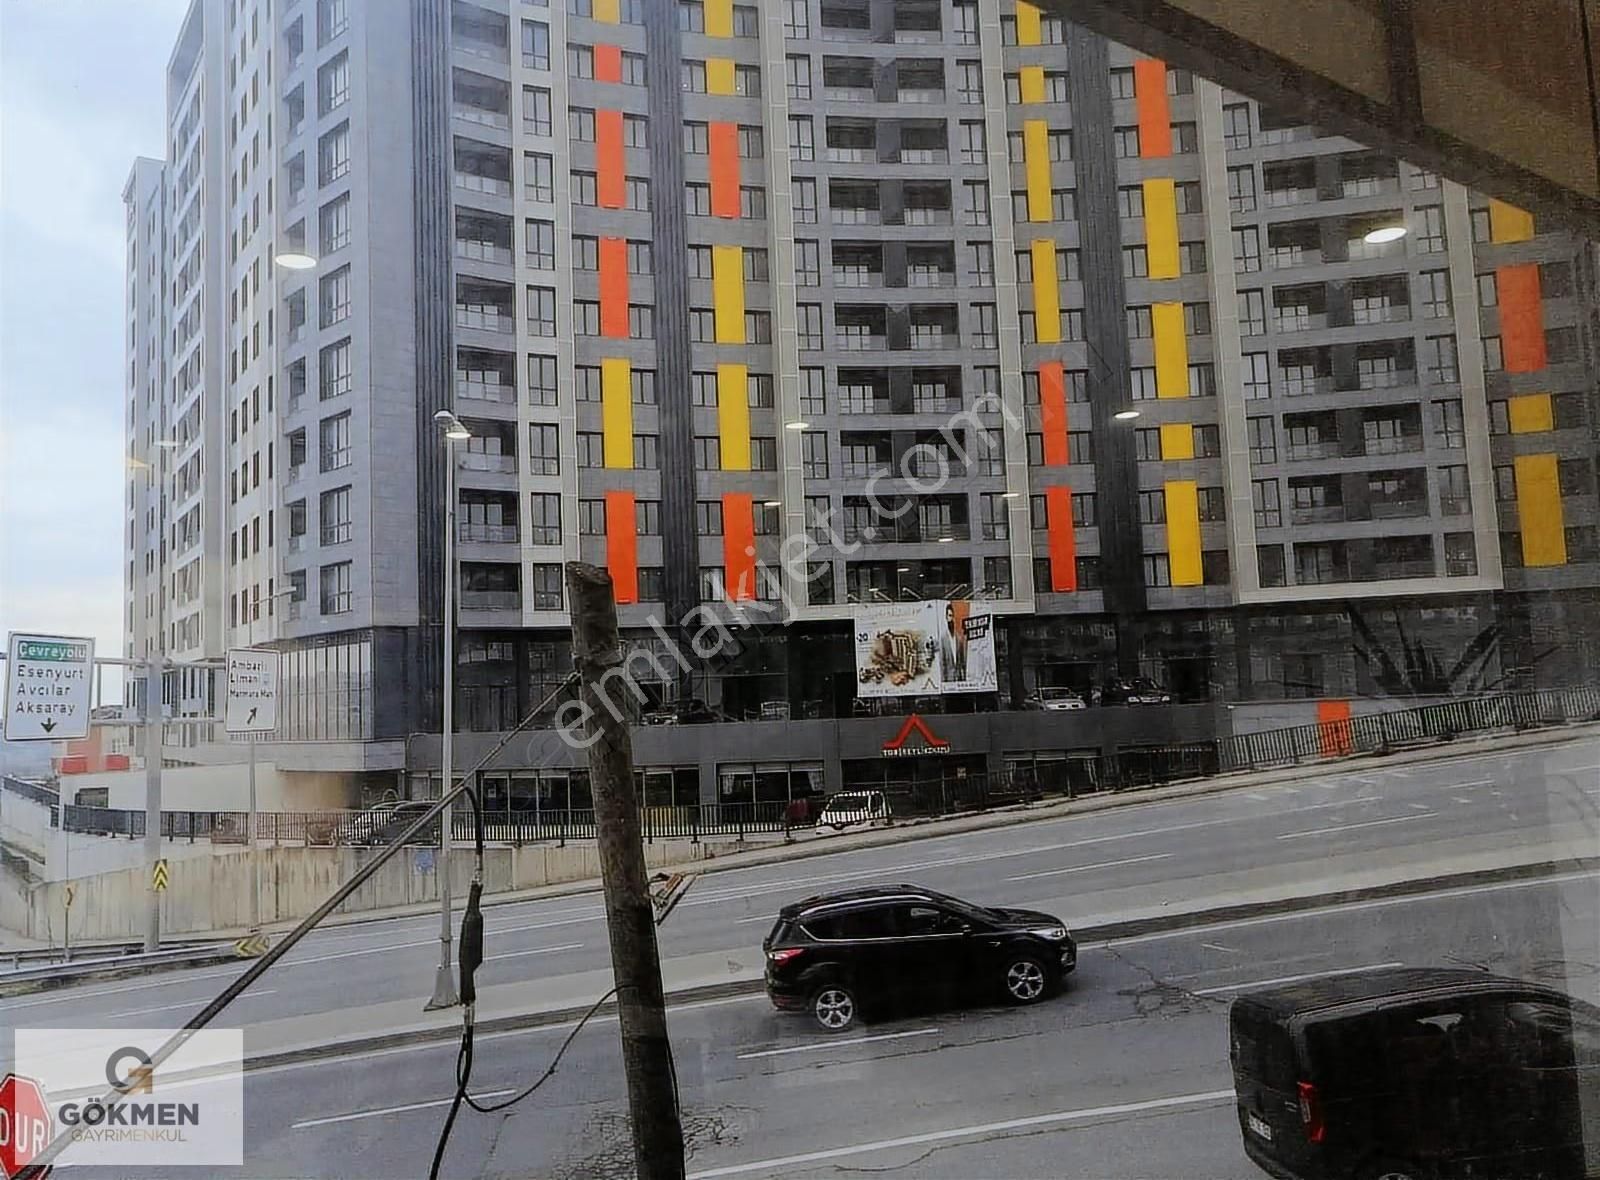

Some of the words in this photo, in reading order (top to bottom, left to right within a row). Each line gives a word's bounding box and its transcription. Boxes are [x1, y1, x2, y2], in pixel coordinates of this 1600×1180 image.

[19, 642, 86, 660] Çevreyolu
[17, 664, 83, 681] Esenyurt
[16, 701, 75, 716] Aksaray
[0, 1107, 45, 1157] DUR
